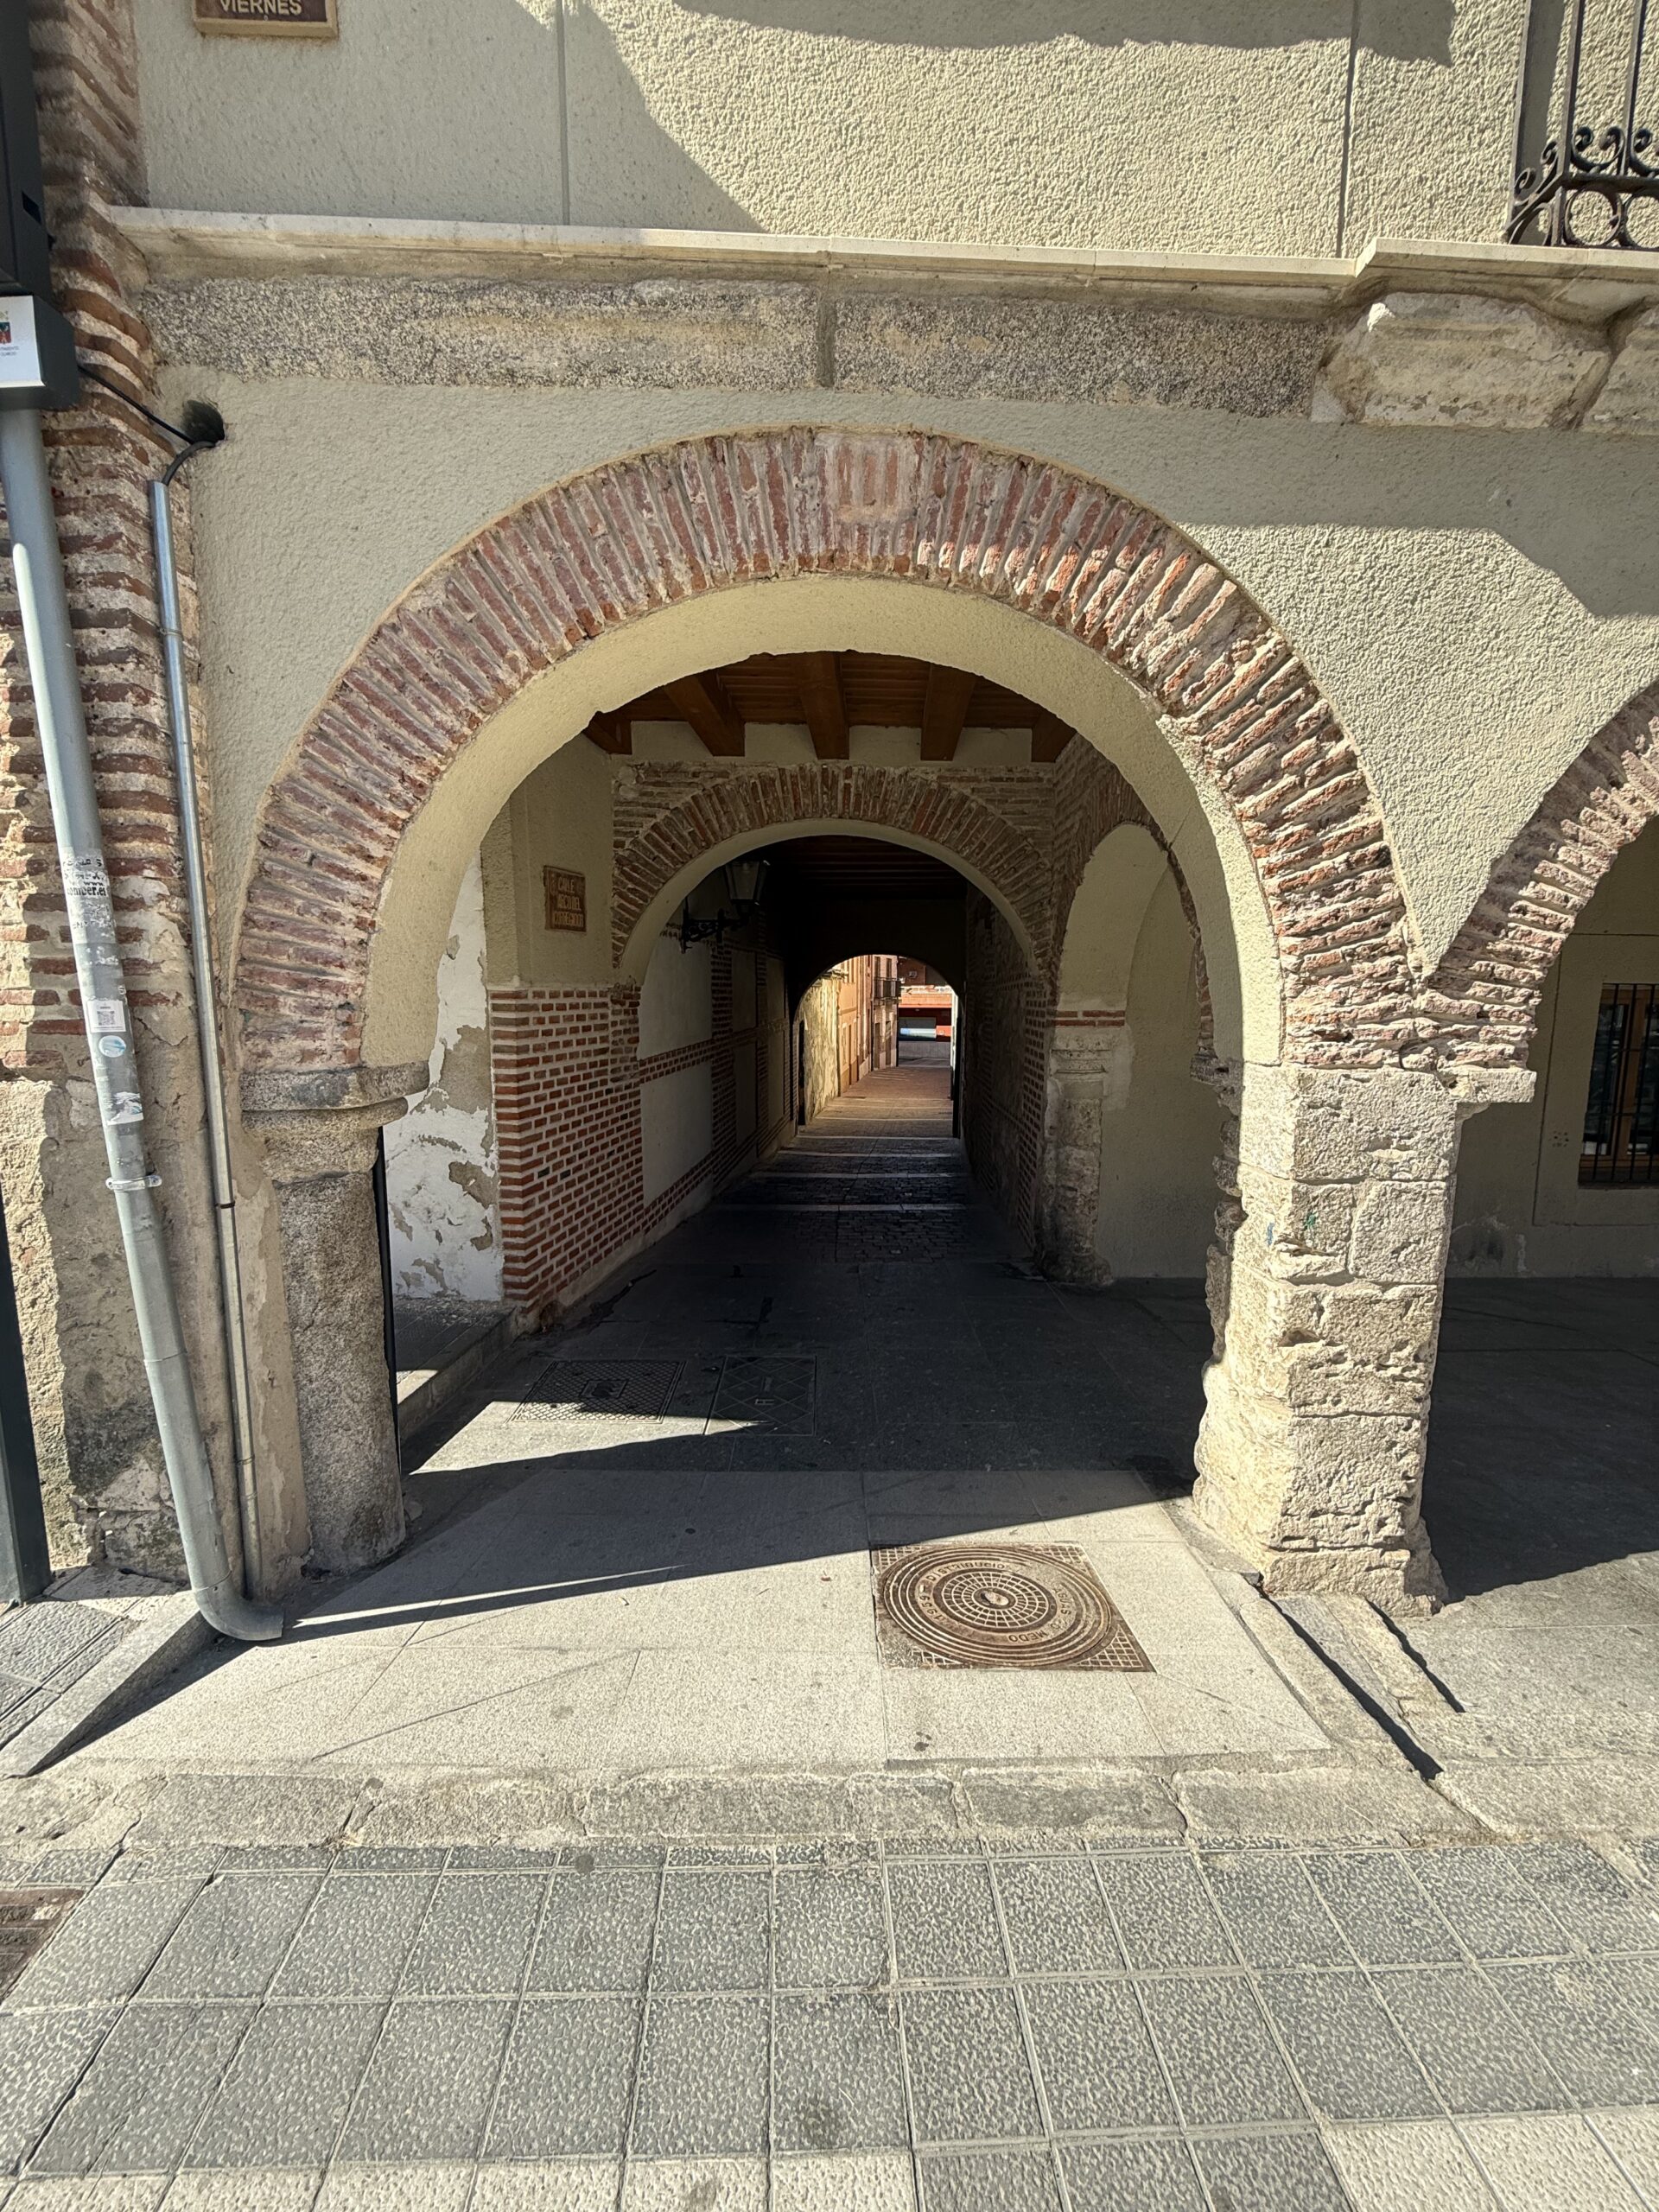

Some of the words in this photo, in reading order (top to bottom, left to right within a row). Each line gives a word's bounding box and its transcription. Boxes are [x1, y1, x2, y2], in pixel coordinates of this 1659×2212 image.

[220, 0, 302, 15] VIERNES
[557, 876, 575, 893] CALLE
[918, 1594, 942, 1621] 1959
